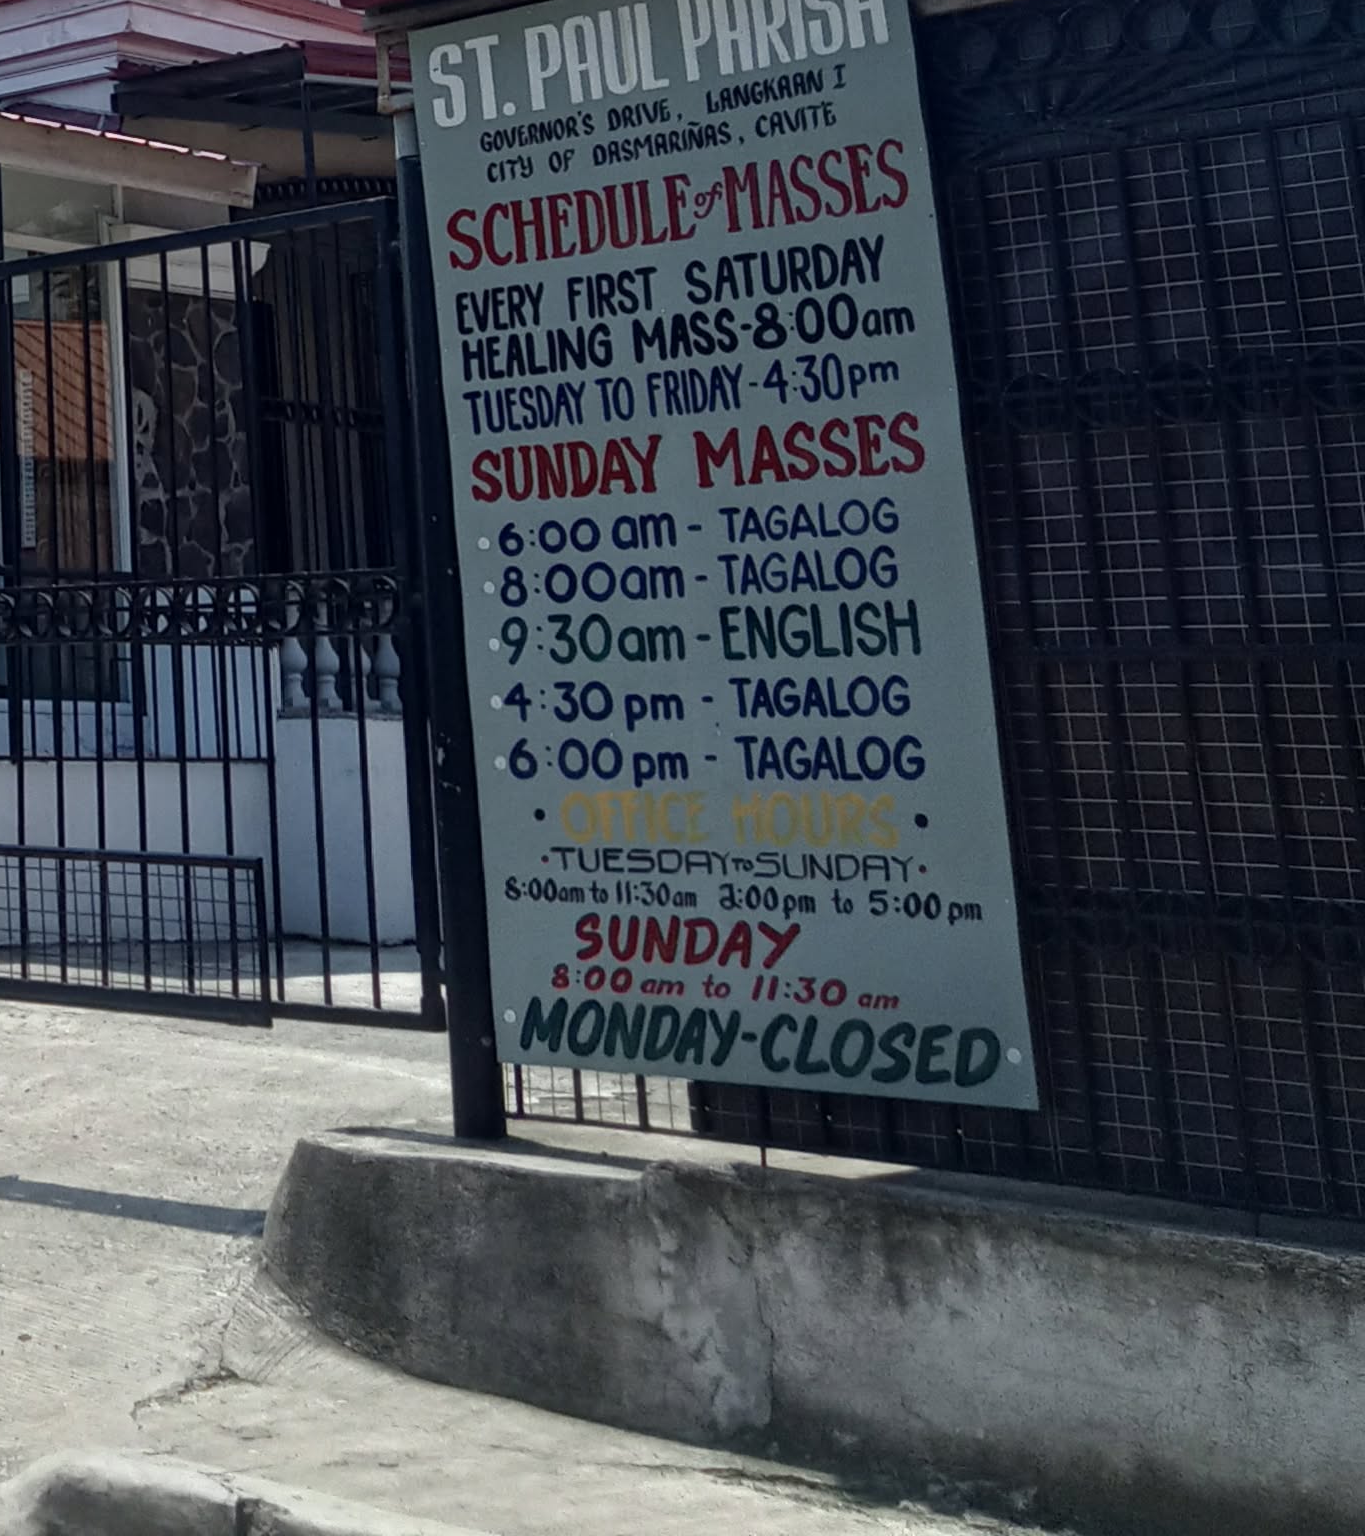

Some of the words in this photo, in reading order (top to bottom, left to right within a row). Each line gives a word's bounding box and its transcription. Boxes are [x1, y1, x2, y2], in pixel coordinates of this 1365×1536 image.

[428, 34, 517, 129] ST.
[524, 2, 670, 112] PAUL
[480, 110, 595, 153] GOVERNOR'S
[706, 68, 824, 115] LANGKAAN
[487, 154, 534, 183] CITY
[548, 148, 576, 174] OF
[755, 100, 837, 139] CAVITE
[446, 173, 697, 271] SCHEDULE
[693, 180, 723, 220] of
[722, 138, 910, 233] MASSES
[455, 281, 544, 336] EVERY
[567, 266, 658, 322] FIRST
[684, 233, 885, 306] SATURDAY
[462, 322, 613, 382] HEALING
[462, 380, 586, 436] TUESDAY
[596, 376, 635, 422] TO
[471, 433, 663, 504] SUNDAY
[693, 410, 926, 489] MASSES
[718, 496, 900, 544] TAGALOG
[717, 544, 899, 596] TAGALOG
[719, 598, 922, 662] ENGLISH
[728, 674, 911, 719] TAGALOG
[734, 734, 927, 782] TAGALOG
[559, 790, 710, 845] OFFICE
[731, 791, 901, 850] HOURS
[550, 846, 730, 877] TUESDAY
[753, 851, 914, 883] SUNDAY
[589, 879, 609, 905] to
[831, 887, 854, 915] to
[575, 912, 801, 970] SUNDAY
[702, 973, 732, 999] to
[751, 974, 848, 1007] 11:30
[857, 992, 901, 1011] am
